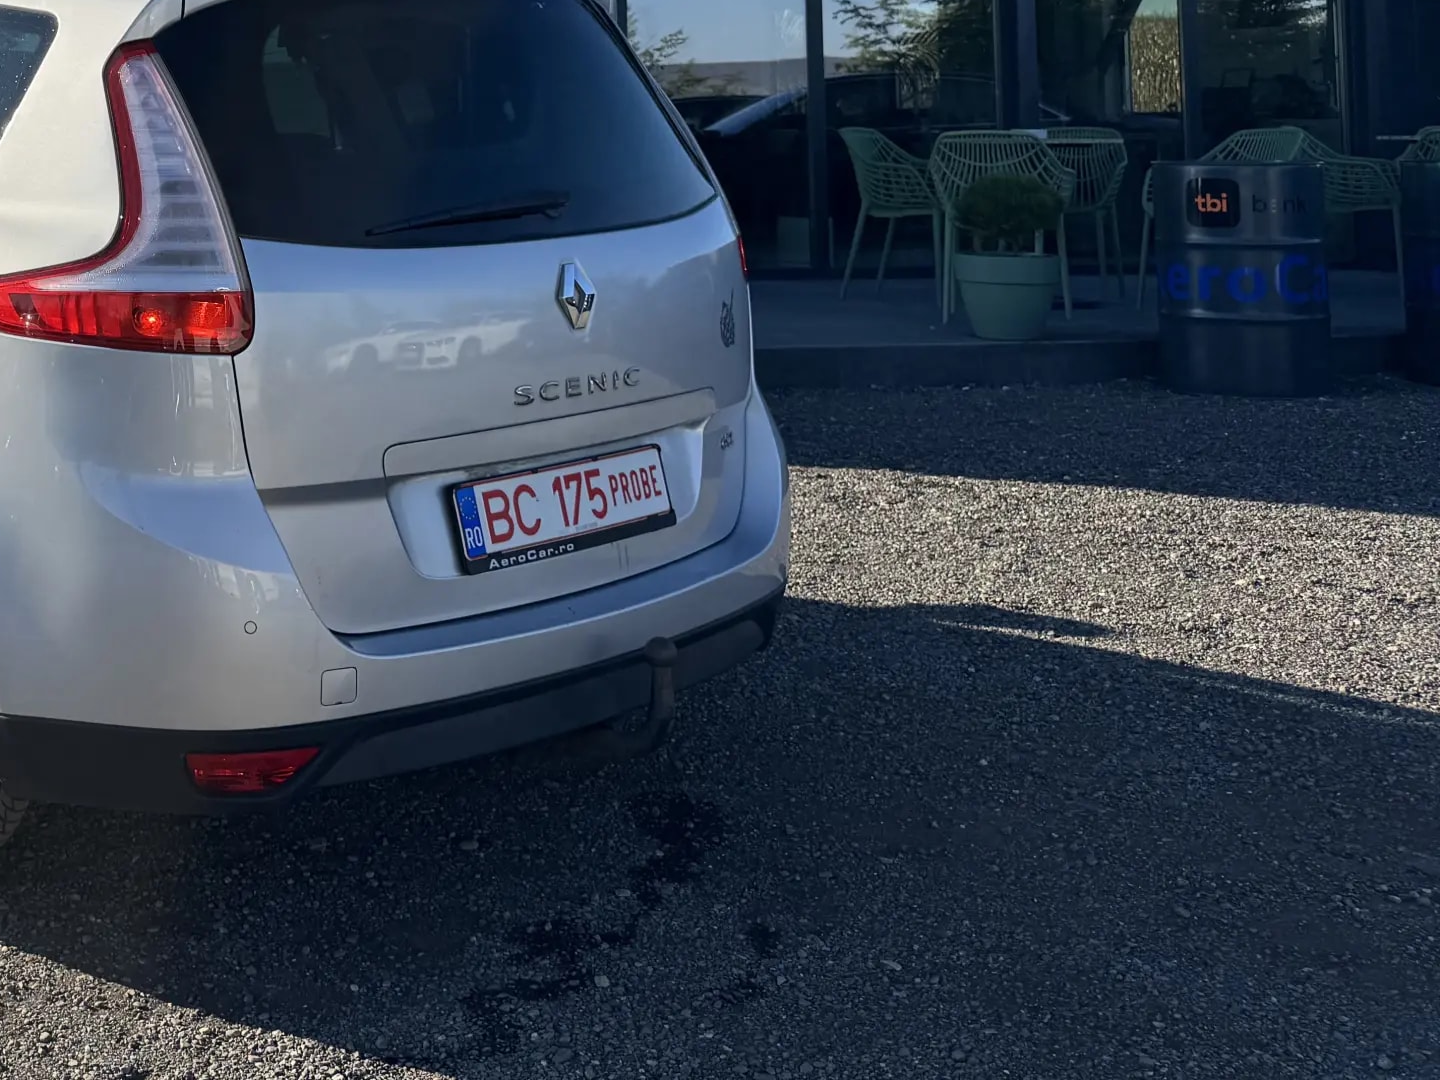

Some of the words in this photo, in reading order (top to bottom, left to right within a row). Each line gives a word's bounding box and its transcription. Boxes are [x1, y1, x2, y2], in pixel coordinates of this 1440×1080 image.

[1195, 193, 1228, 214] tbi
[513, 366, 641, 406] SCENIC
[464, 526, 484, 550] RO
[481, 483, 542, 545] BC
[551, 468, 608, 528] 175
[608, 464, 662, 507] PROBE
[488, 542, 575, 570] AeroCar.ro
